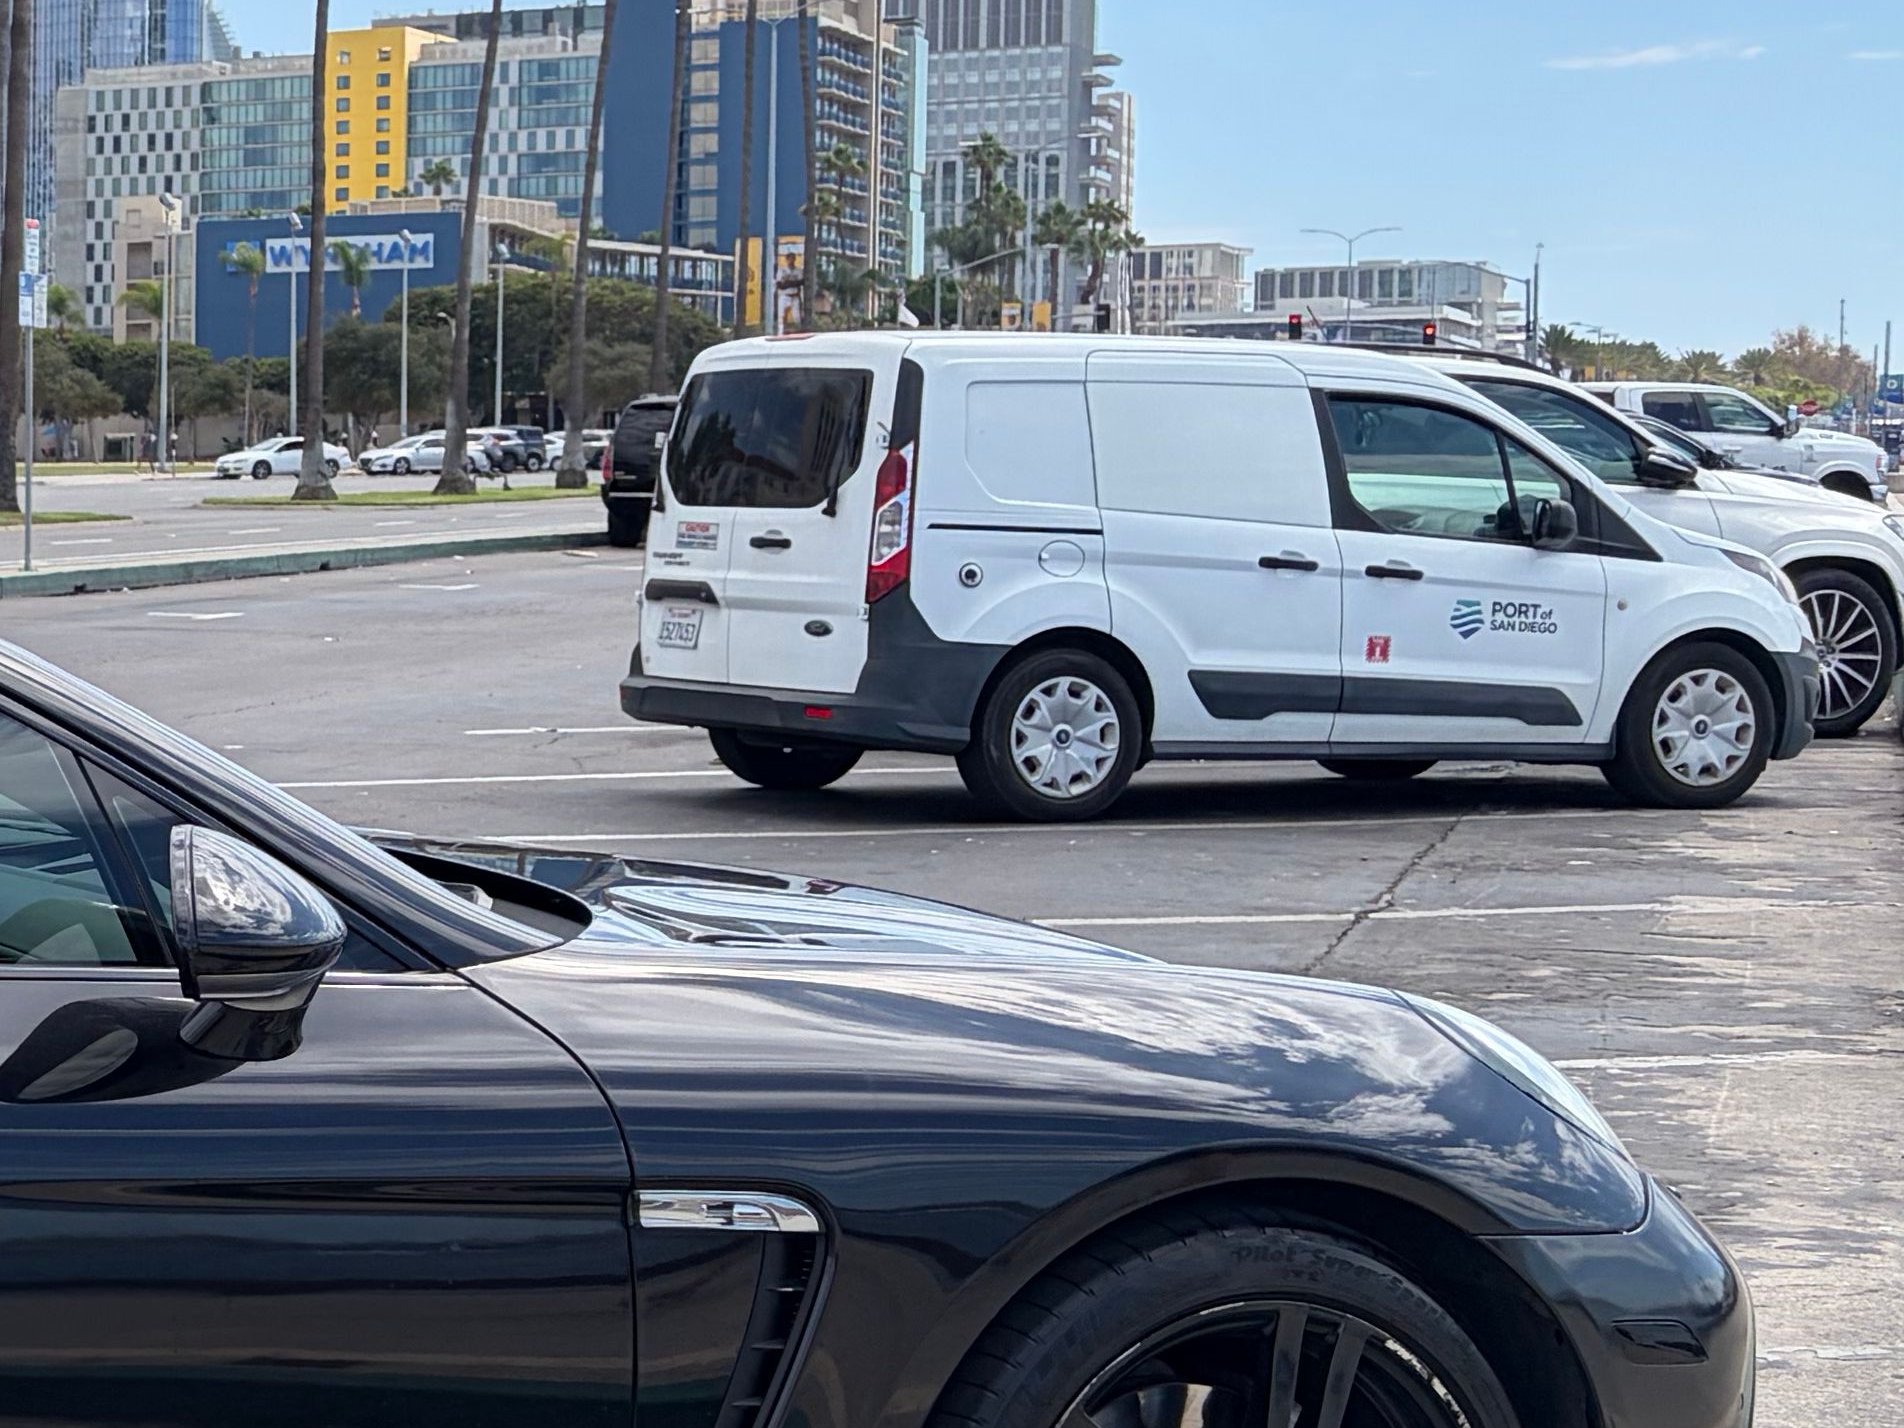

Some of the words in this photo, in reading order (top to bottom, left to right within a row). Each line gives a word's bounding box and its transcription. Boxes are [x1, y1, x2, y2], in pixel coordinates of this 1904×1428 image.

[1492, 601, 1541, 620] PORT
[1540, 608, 1553, 620] of
[1490, 620, 1516, 632] SAN
[1518, 621, 1558, 634] DIEGO
